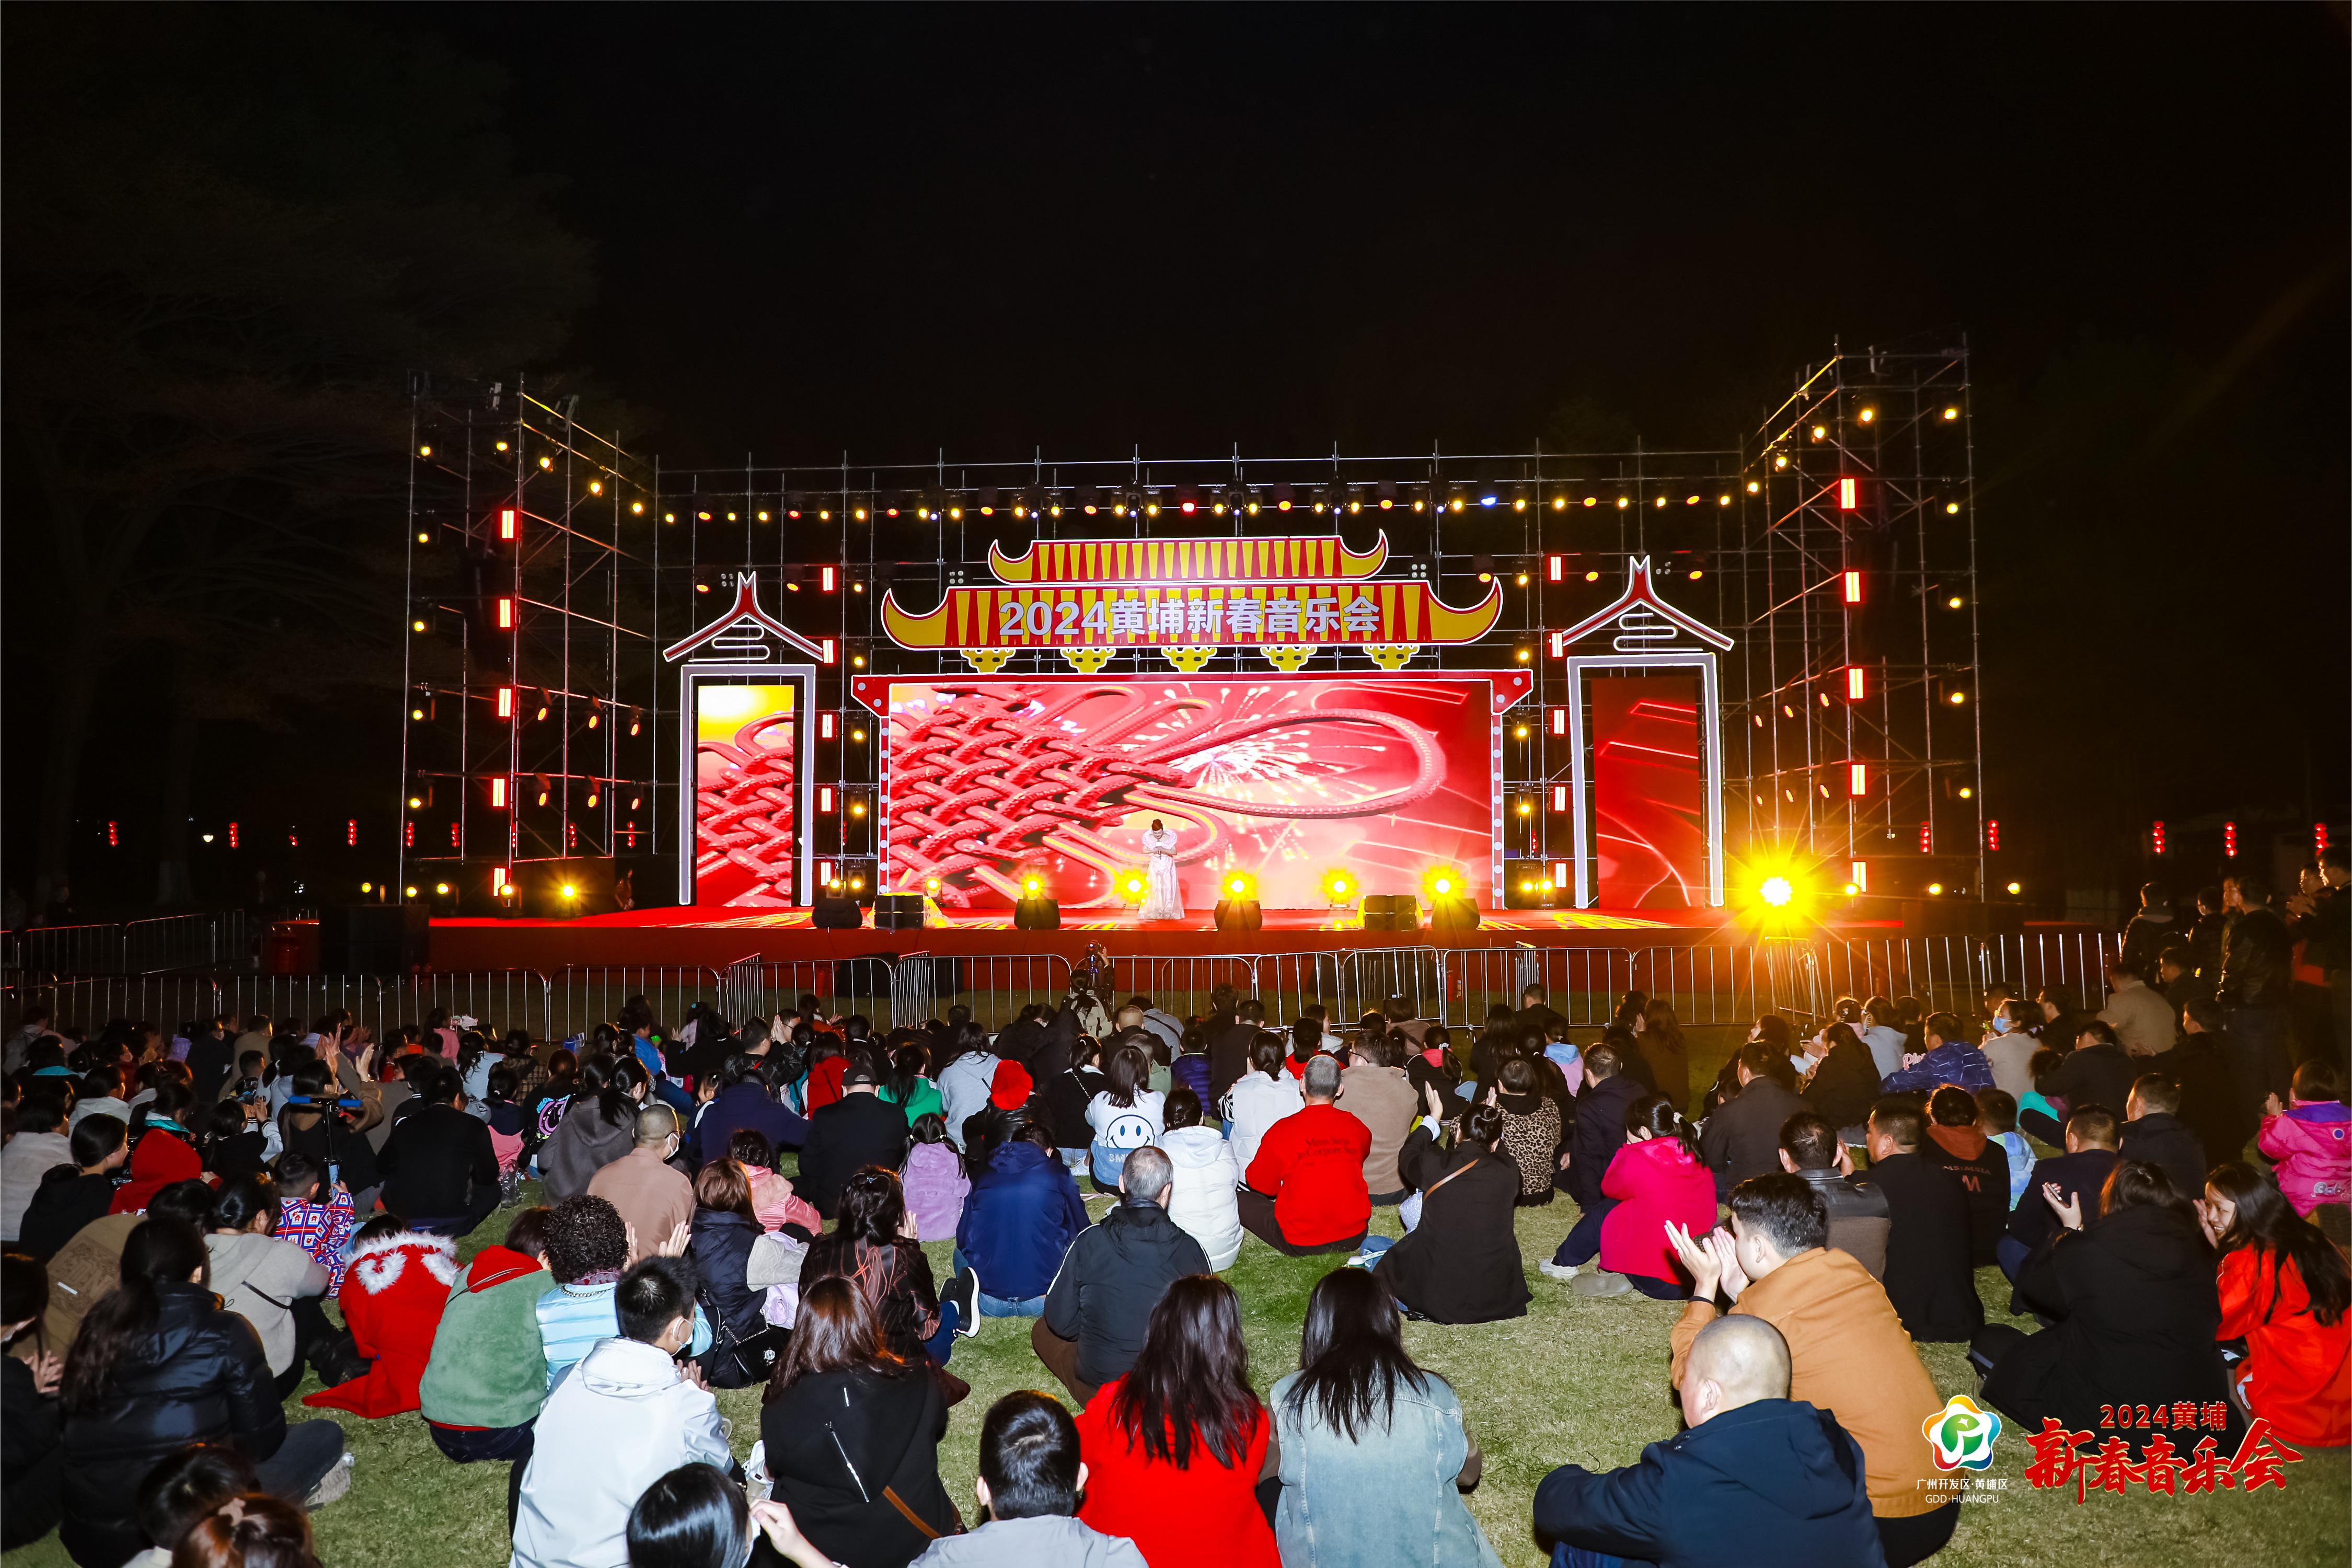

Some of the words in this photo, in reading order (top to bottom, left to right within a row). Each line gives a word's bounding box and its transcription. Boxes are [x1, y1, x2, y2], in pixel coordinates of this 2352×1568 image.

[999, 595, 1380, 637] 2024黄埔新春音乐会
